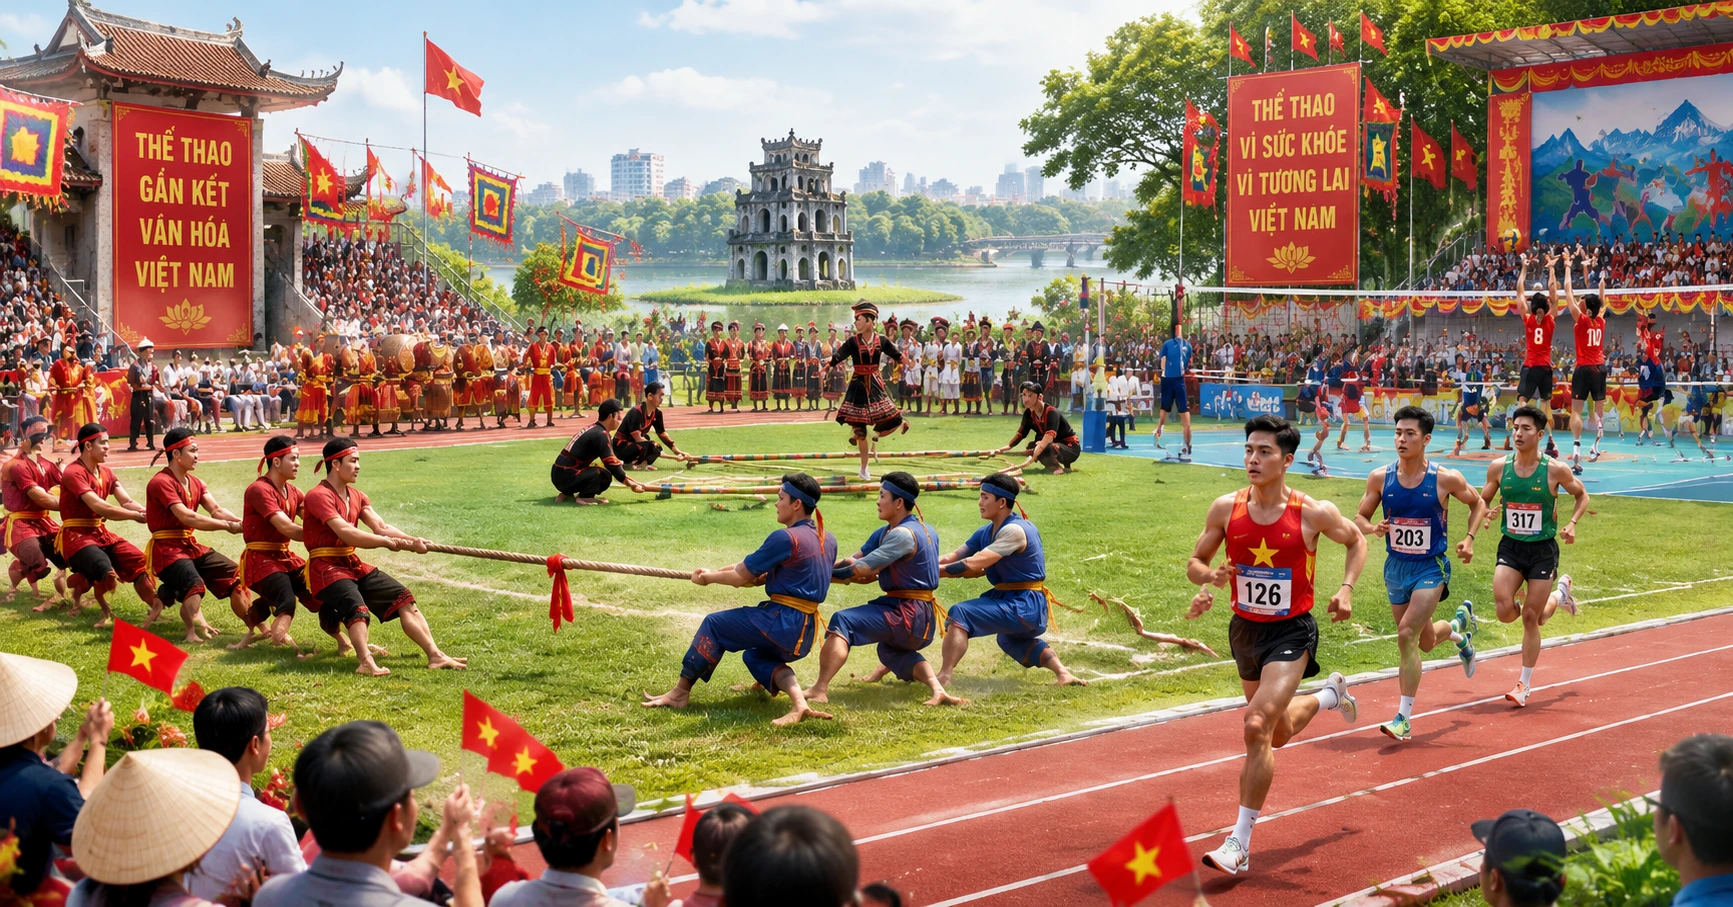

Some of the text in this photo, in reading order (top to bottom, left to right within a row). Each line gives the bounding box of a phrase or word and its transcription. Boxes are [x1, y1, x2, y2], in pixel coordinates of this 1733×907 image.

[1289, 92, 1335, 119] THAO
[180, 137, 232, 168] THAO
[192, 172, 230, 207] KẾT
[1258, 168, 1317, 195] TƯƠNG
[1322, 167, 1350, 192] LAI
[135, 254, 235, 293] VIỆT NAM
[1534, 327, 1544, 345] 8
[1511, 512, 1536, 529] 317
[1395, 528, 1424, 547] 203
[1245, 581, 1281, 606] 126
